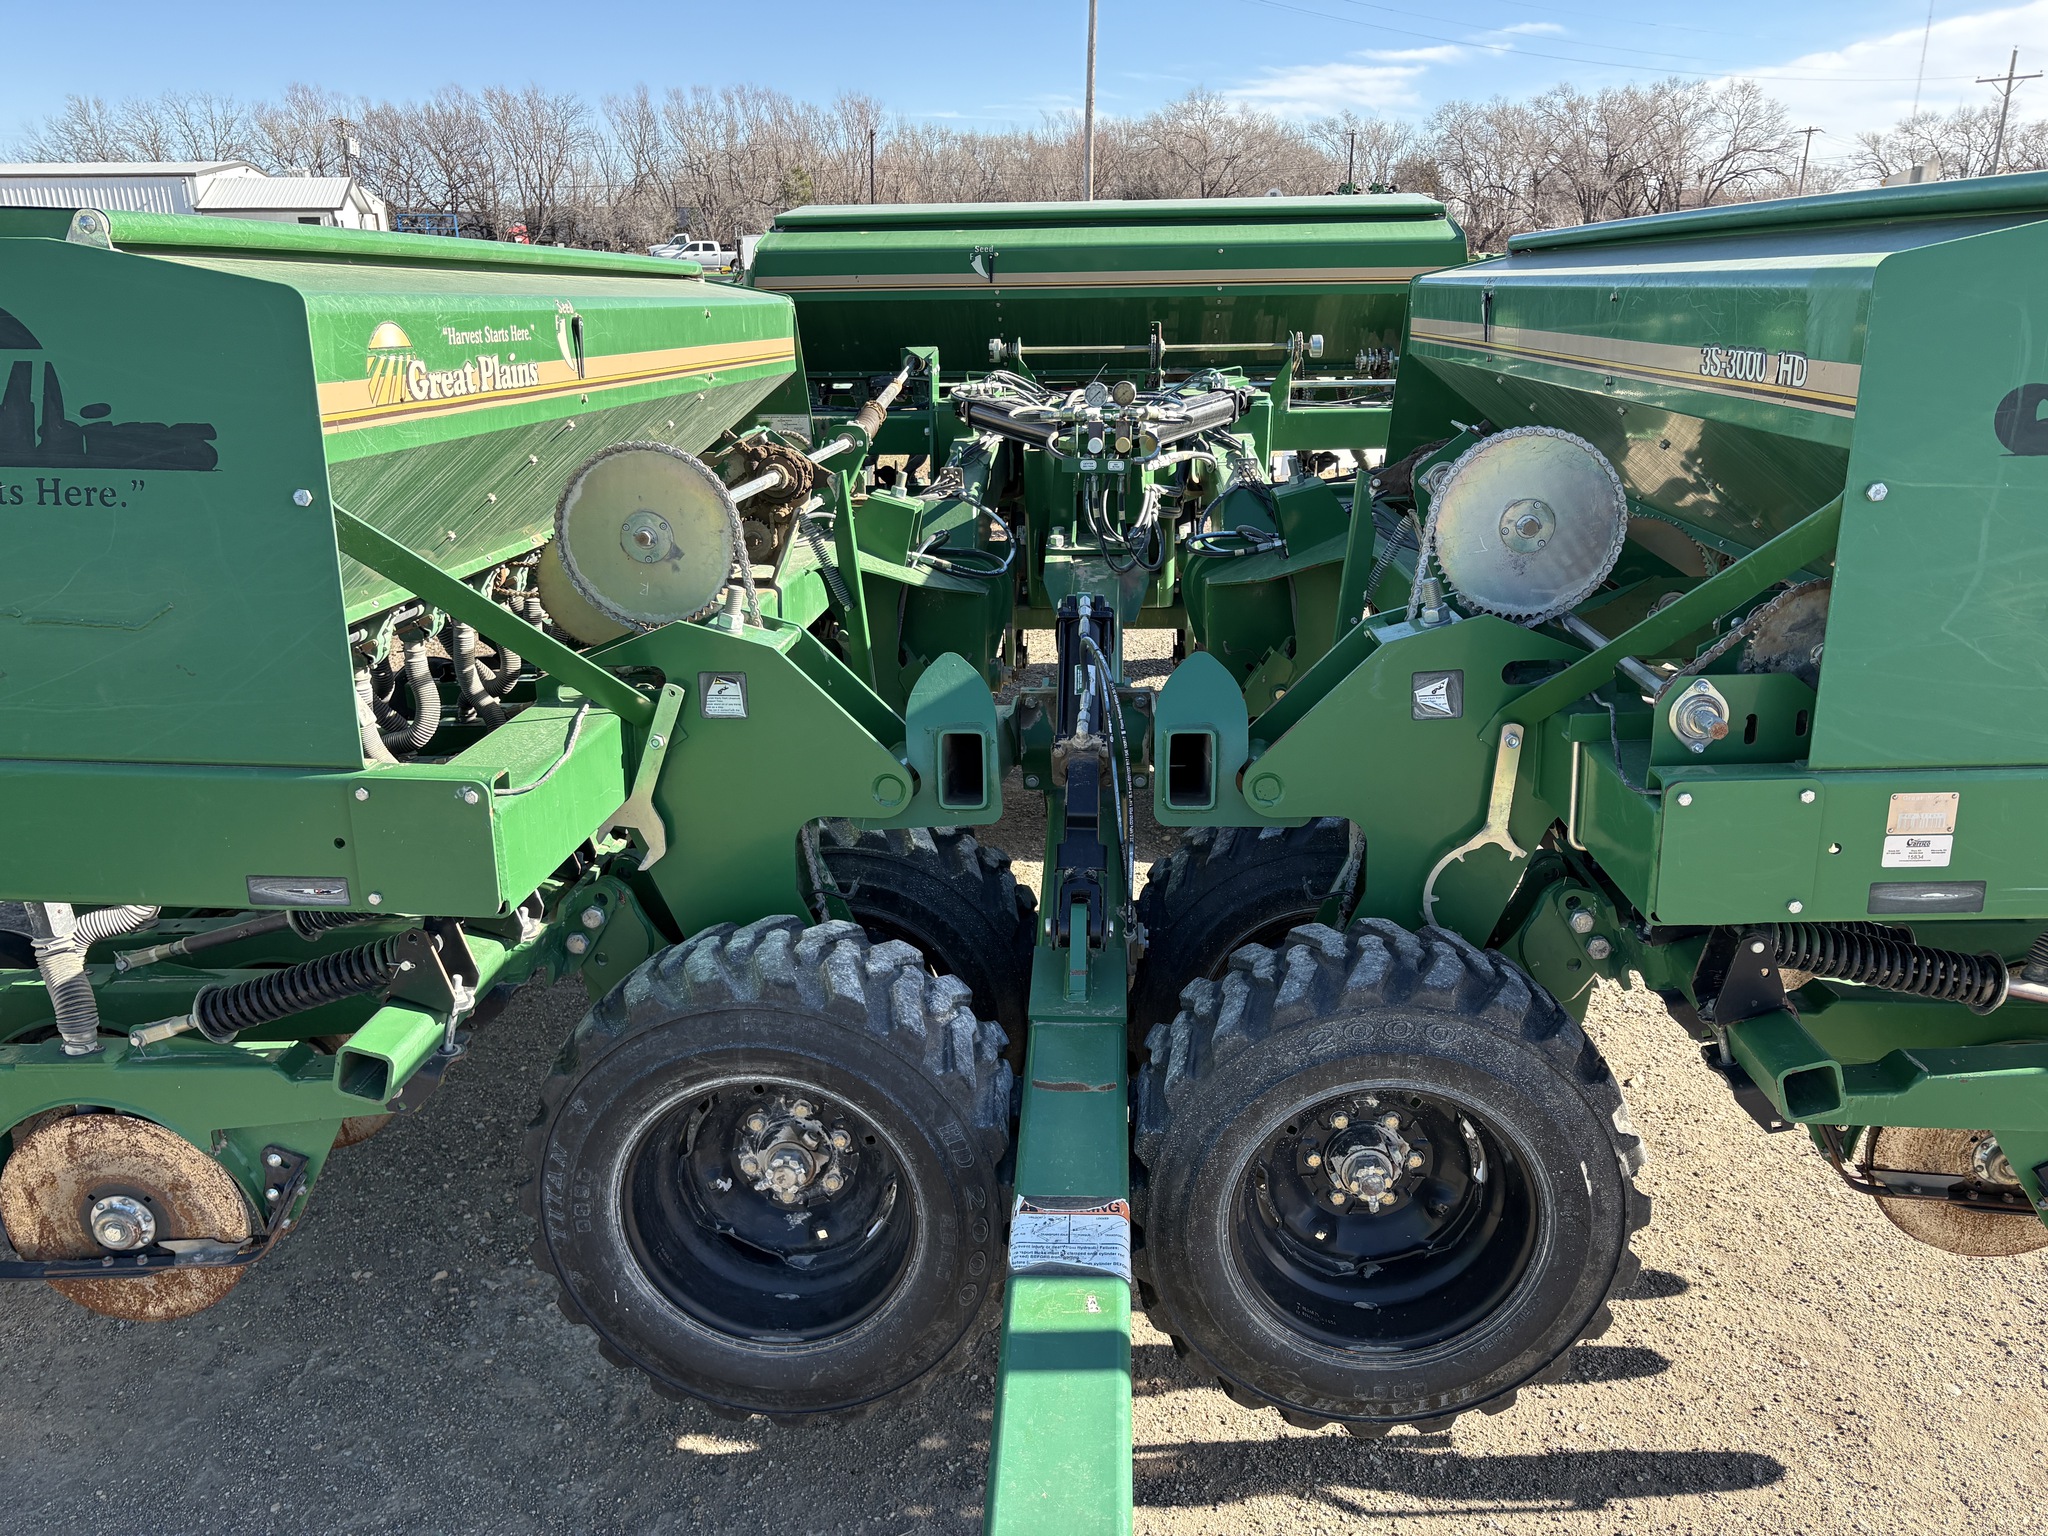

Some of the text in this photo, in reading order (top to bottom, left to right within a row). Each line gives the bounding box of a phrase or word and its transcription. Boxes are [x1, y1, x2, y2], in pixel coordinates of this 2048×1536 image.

[974, 244, 994, 253] Seed
[442, 323, 535, 346] “Harvest Starts Here.”
[406, 352, 540, 401] Great Plains
[1700, 344, 1808, 388] 3S-3000 HD
[36, 477, 145, 508] Here.”
[1306, 1020, 1456, 1053] 2000
[544, 1140, 569, 1241] TITAN
[958, 1186, 990, 1307] 2000
